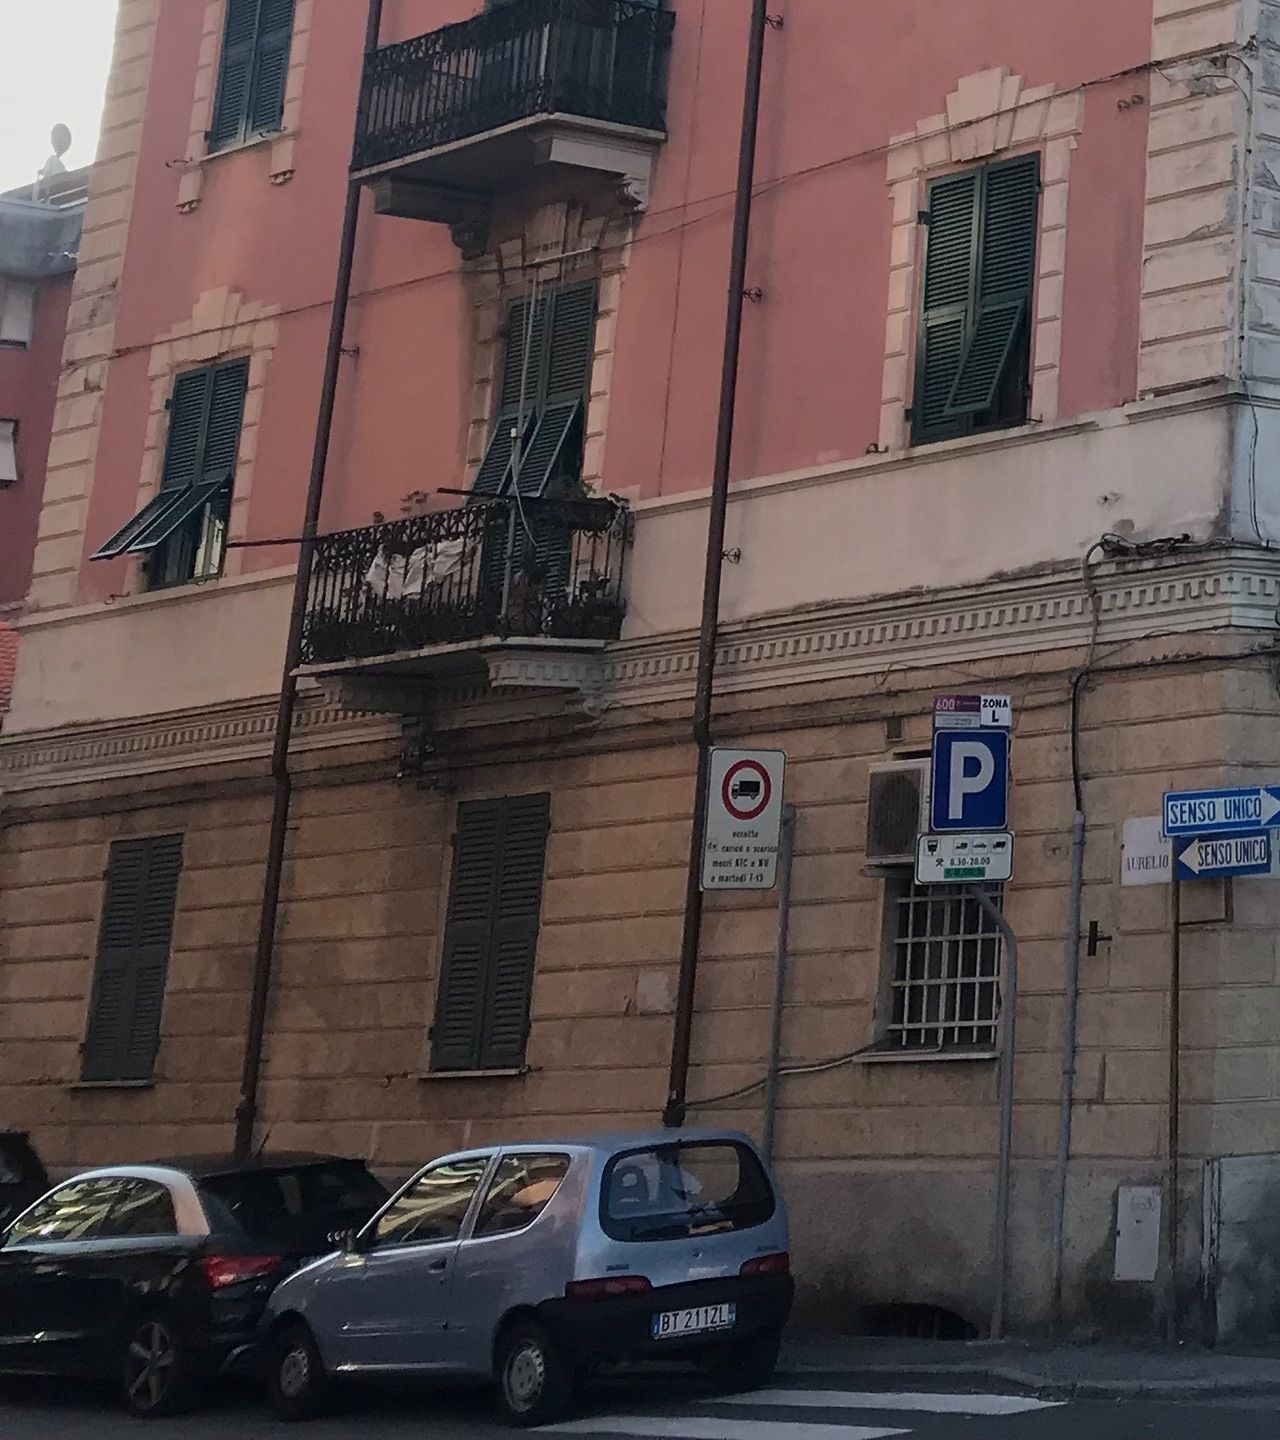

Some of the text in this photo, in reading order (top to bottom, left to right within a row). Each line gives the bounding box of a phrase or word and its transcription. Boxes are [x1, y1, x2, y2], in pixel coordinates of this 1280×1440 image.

[983, 698, 1009, 708] ZONA
[992, 709, 999, 722] L
[948, 741, 995, 820] P
[1170, 797, 1262, 824] SENSO UNICO
[1125, 854, 1169, 871] AURELIO
[1198, 839, 1267, 867] SENSO UNICO
[662, 1307, 727, 1332] BT 211ZL
